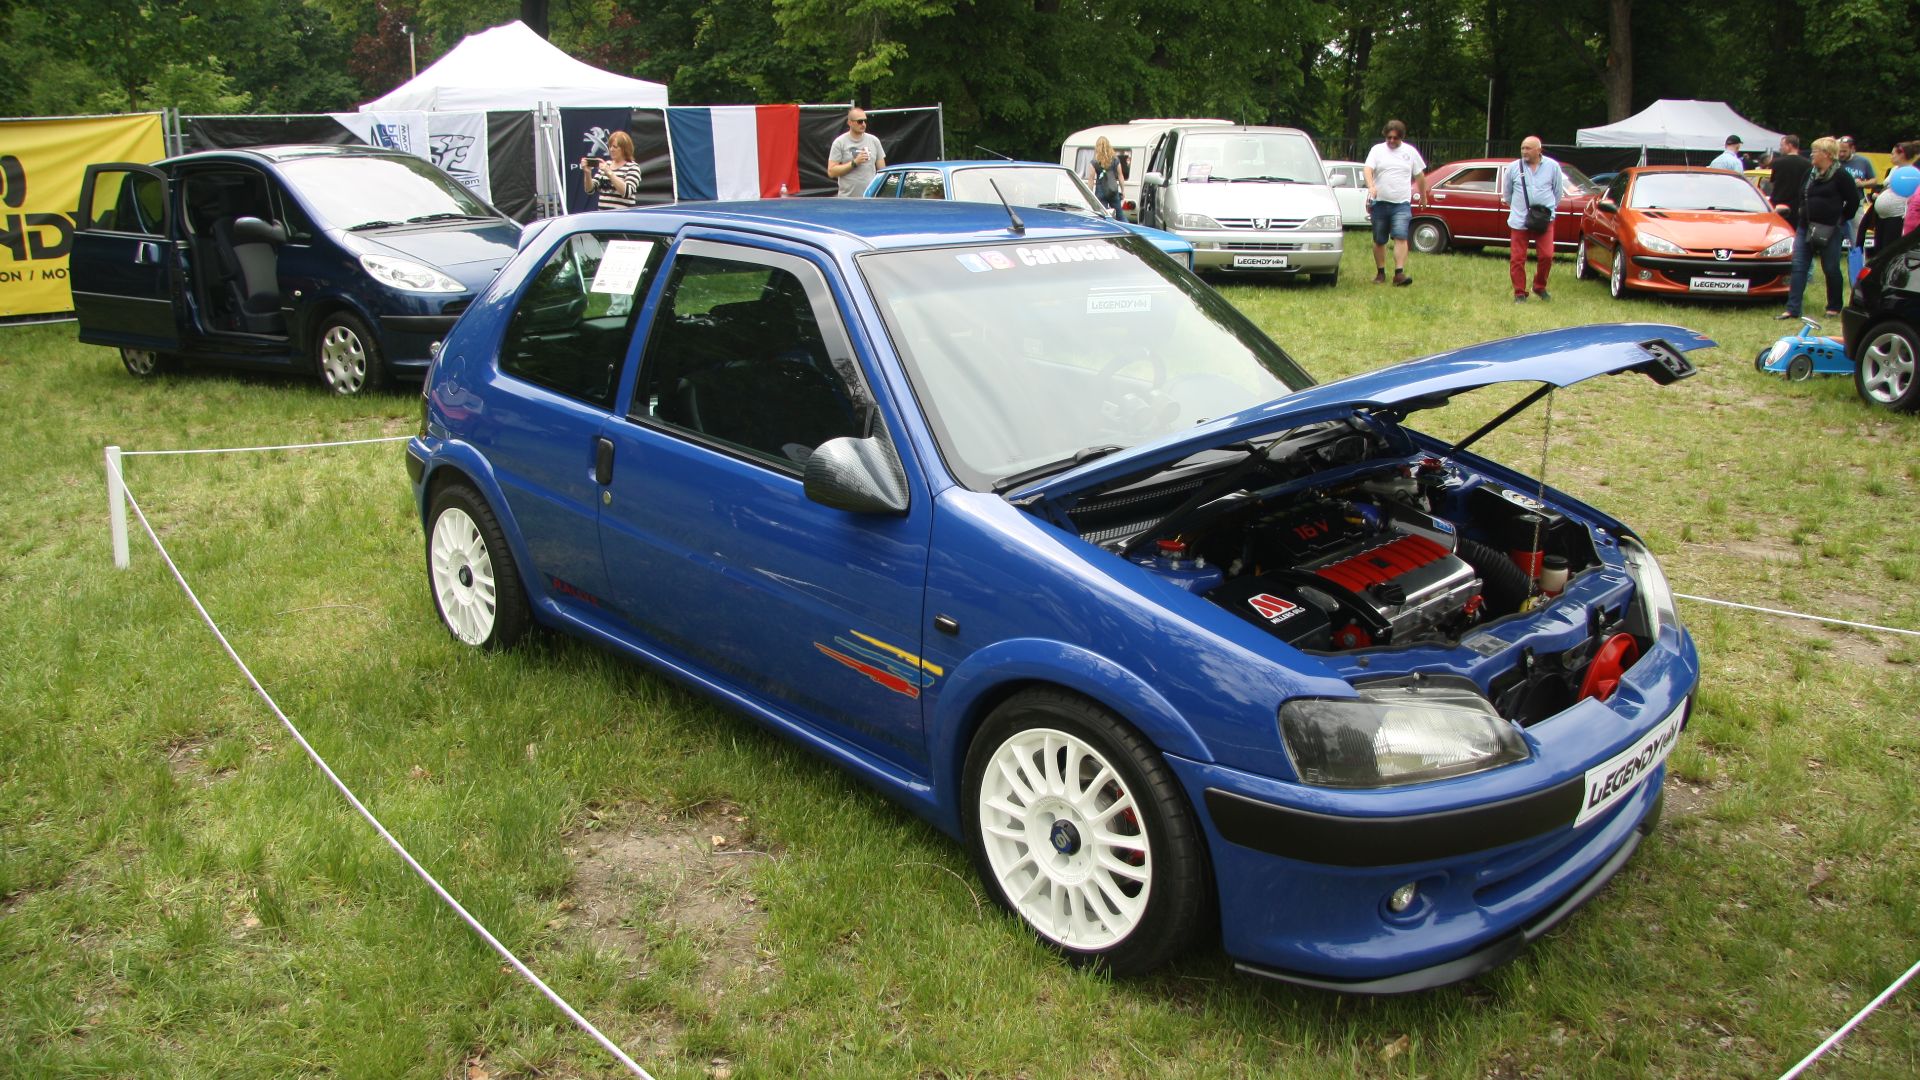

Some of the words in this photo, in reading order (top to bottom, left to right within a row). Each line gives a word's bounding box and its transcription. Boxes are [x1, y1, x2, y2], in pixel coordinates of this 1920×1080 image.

[42, 267, 70, 280] MO
[1694, 281, 1732, 289] LEGENDY
[1587, 735, 1663, 810] LEGENDY
